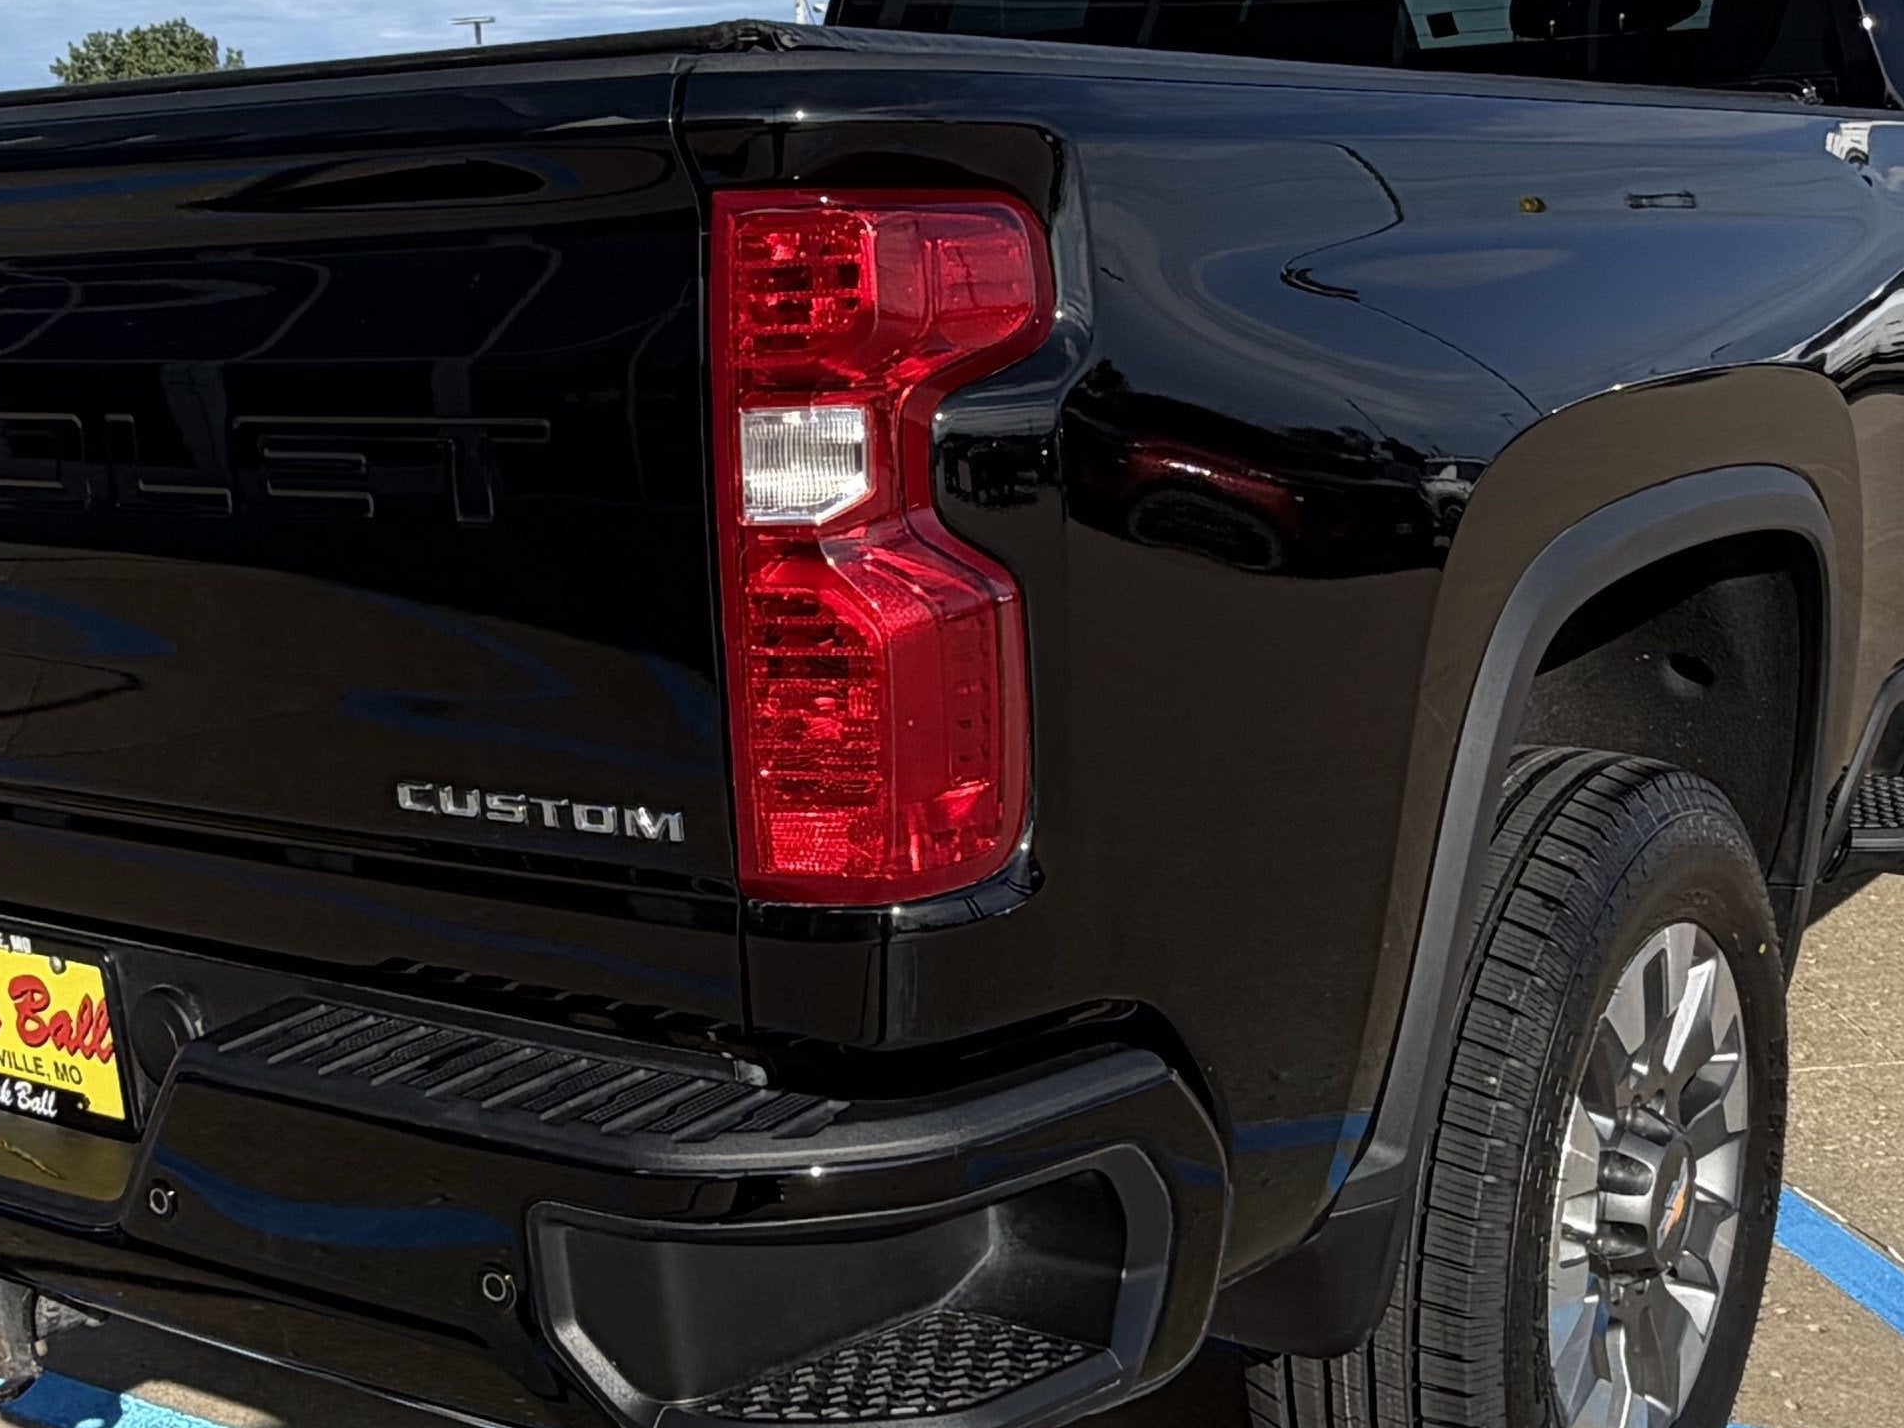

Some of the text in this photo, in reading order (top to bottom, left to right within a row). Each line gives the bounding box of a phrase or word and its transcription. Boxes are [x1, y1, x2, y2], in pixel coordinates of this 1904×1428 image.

[396, 780, 685, 843] CUSTOM
[8, 974, 115, 1063] Ball
[55, 1060, 83, 1086] MO
[14, 1082, 57, 1118] Ball
